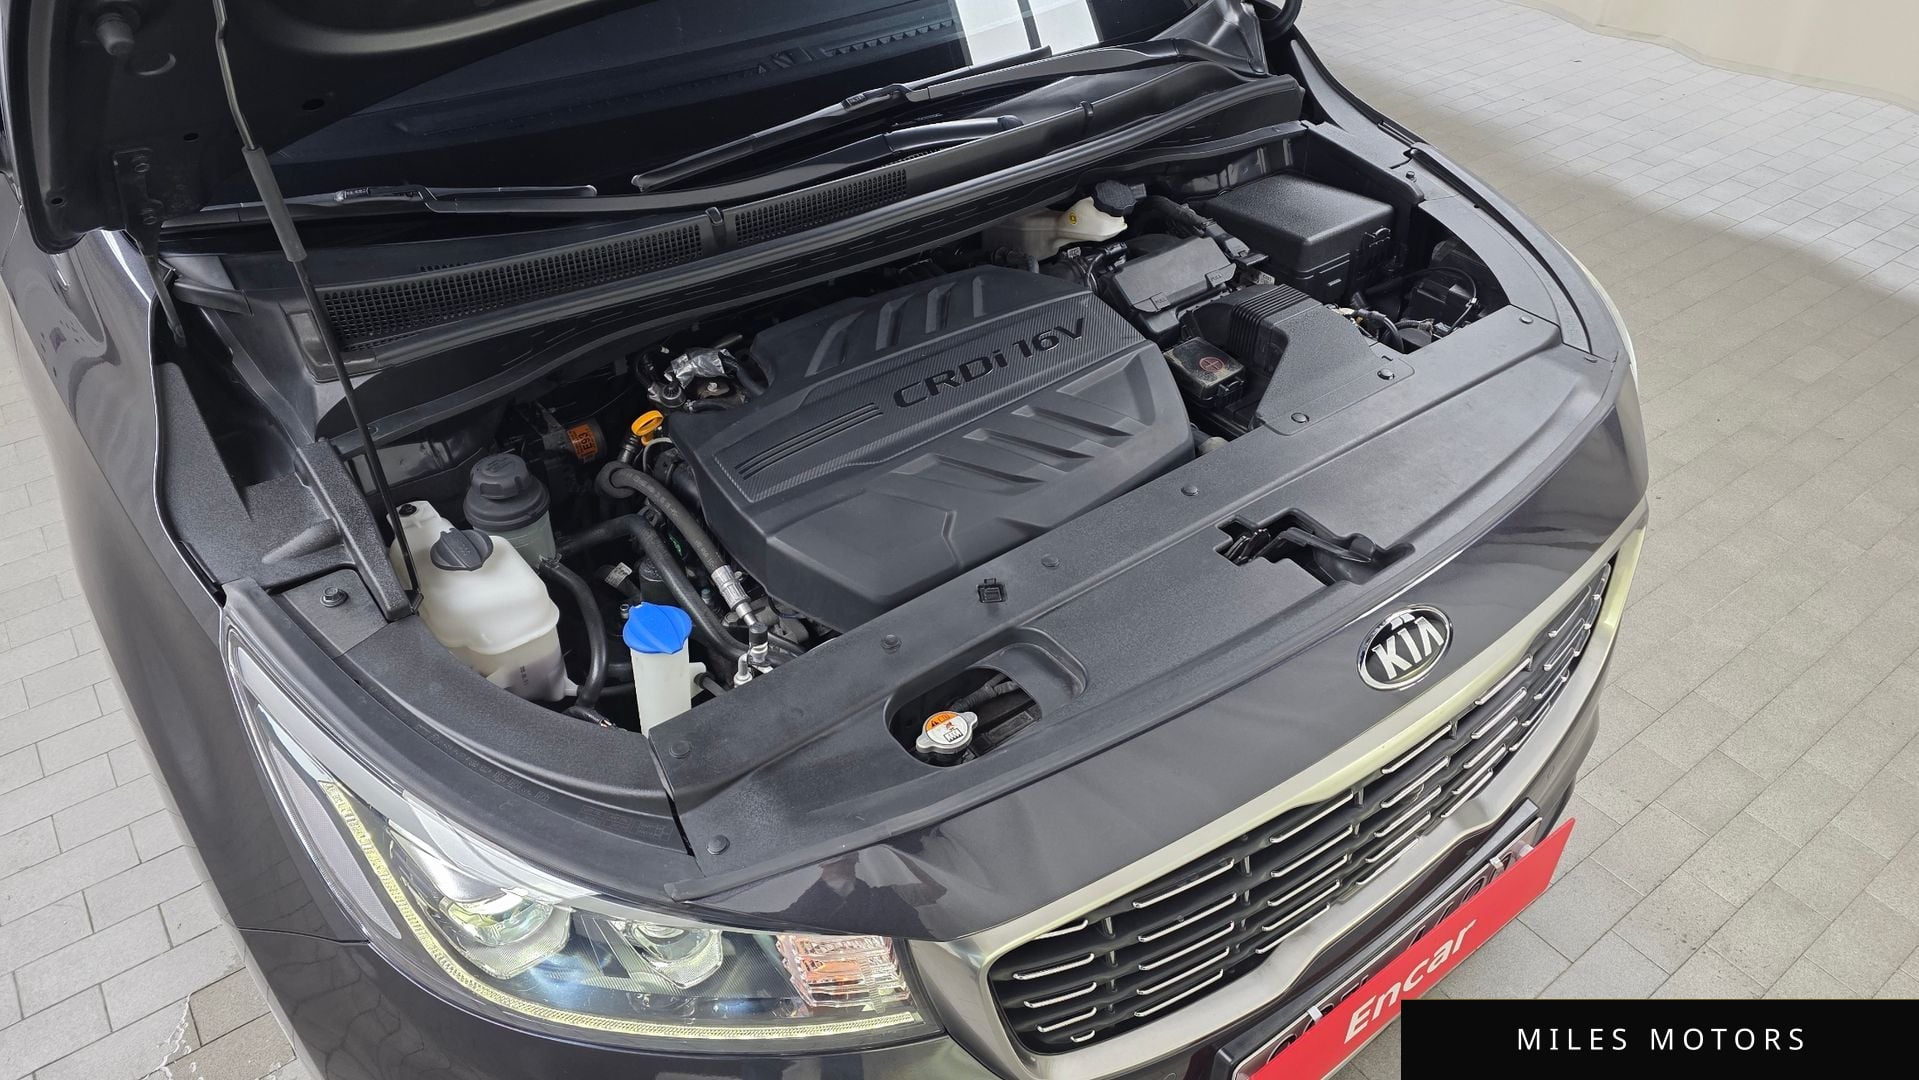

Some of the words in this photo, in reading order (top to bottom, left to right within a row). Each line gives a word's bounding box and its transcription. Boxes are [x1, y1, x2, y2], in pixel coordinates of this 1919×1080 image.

[893, 350, 1008, 408] CRDi
[1012, 317, 1085, 358] 16V
[577, 432, 593, 451] E93
[1371, 616, 1444, 680] KIA
[1344, 919, 1477, 1045] Encar
